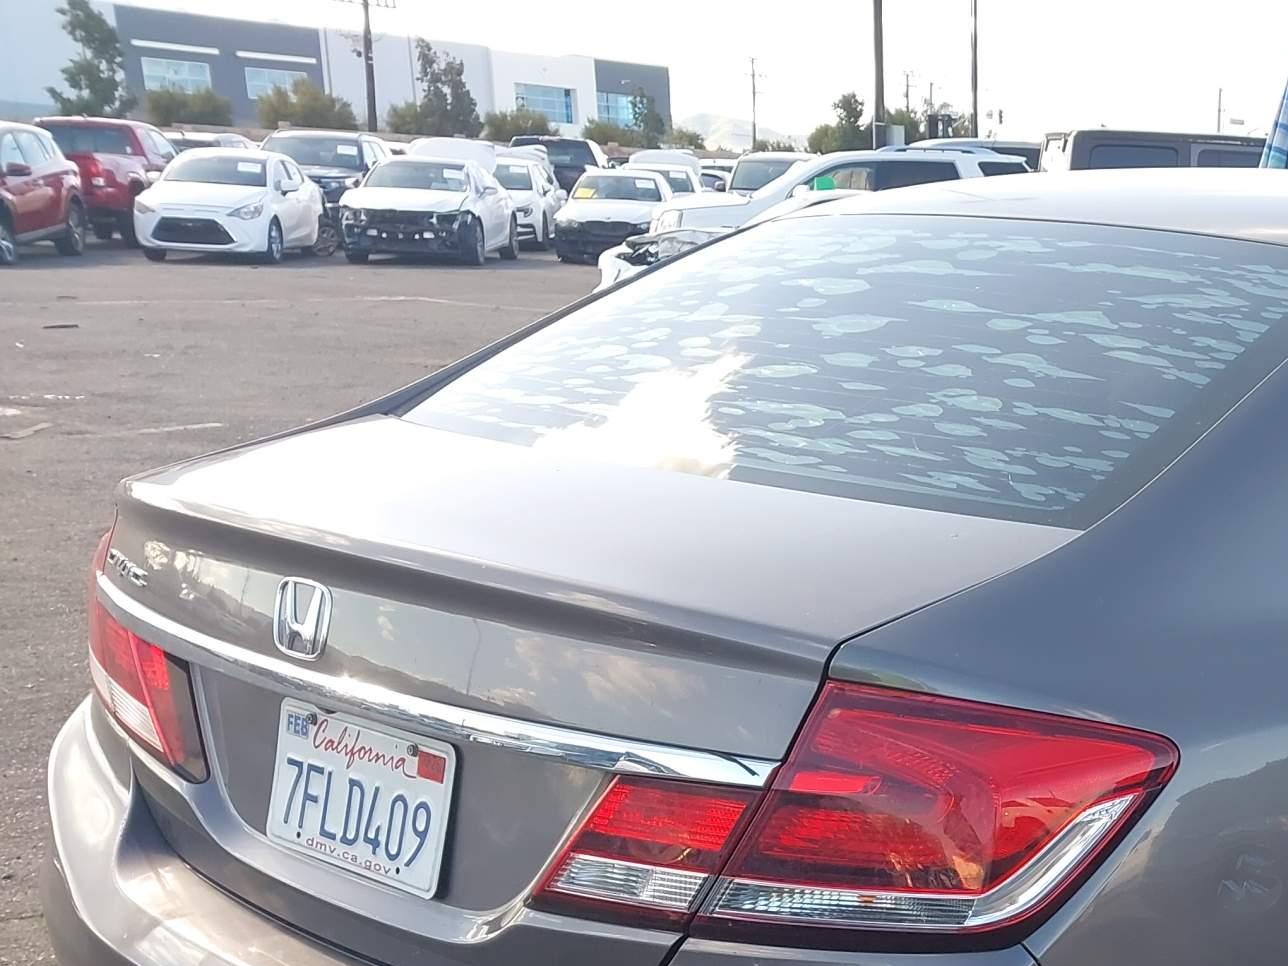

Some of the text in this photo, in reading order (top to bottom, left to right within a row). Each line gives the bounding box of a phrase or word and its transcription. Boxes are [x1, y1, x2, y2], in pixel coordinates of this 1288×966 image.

[287, 713, 308, 735] FEB
[313, 718, 416, 778] California
[284, 757, 431, 867] 7FLD409
[306, 836, 391, 875] dmv.ca.gov
